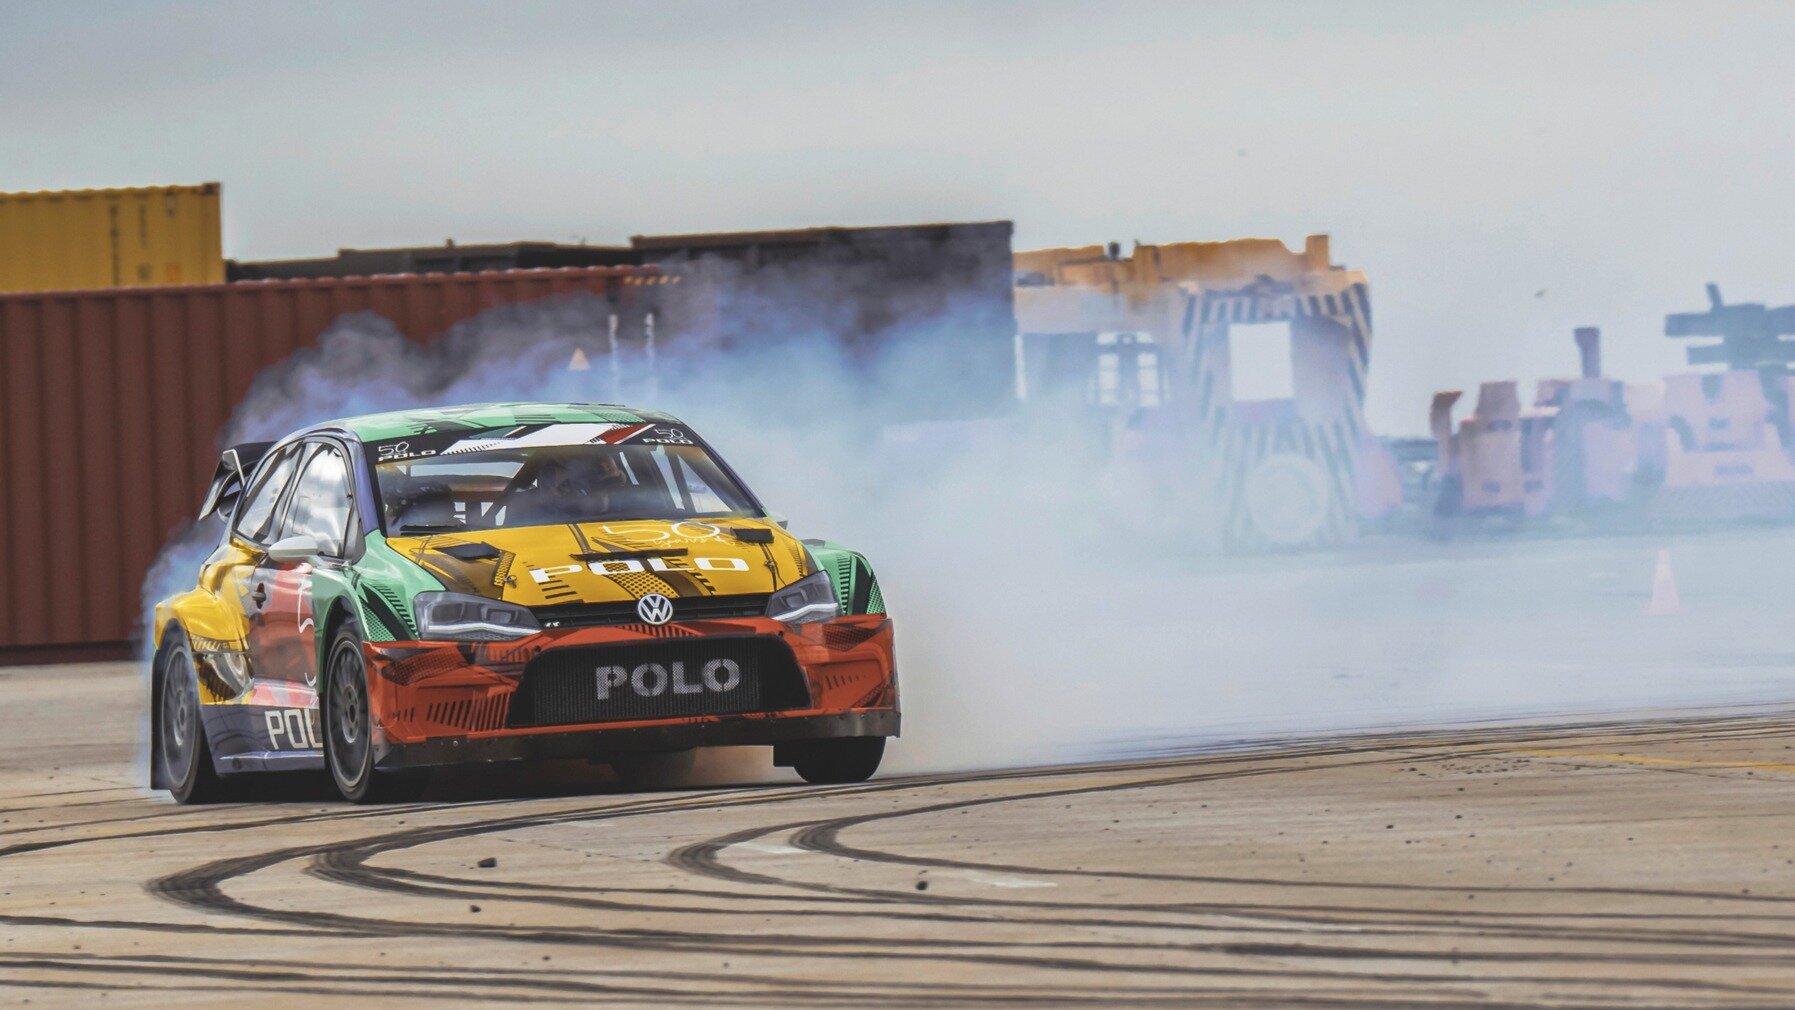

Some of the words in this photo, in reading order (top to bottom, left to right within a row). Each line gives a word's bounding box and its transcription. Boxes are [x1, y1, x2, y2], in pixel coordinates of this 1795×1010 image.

[378, 449, 436, 461] POLO
[601, 521, 721, 542] 50
[529, 557, 750, 584] POLO
[596, 658, 740, 700] POLO
